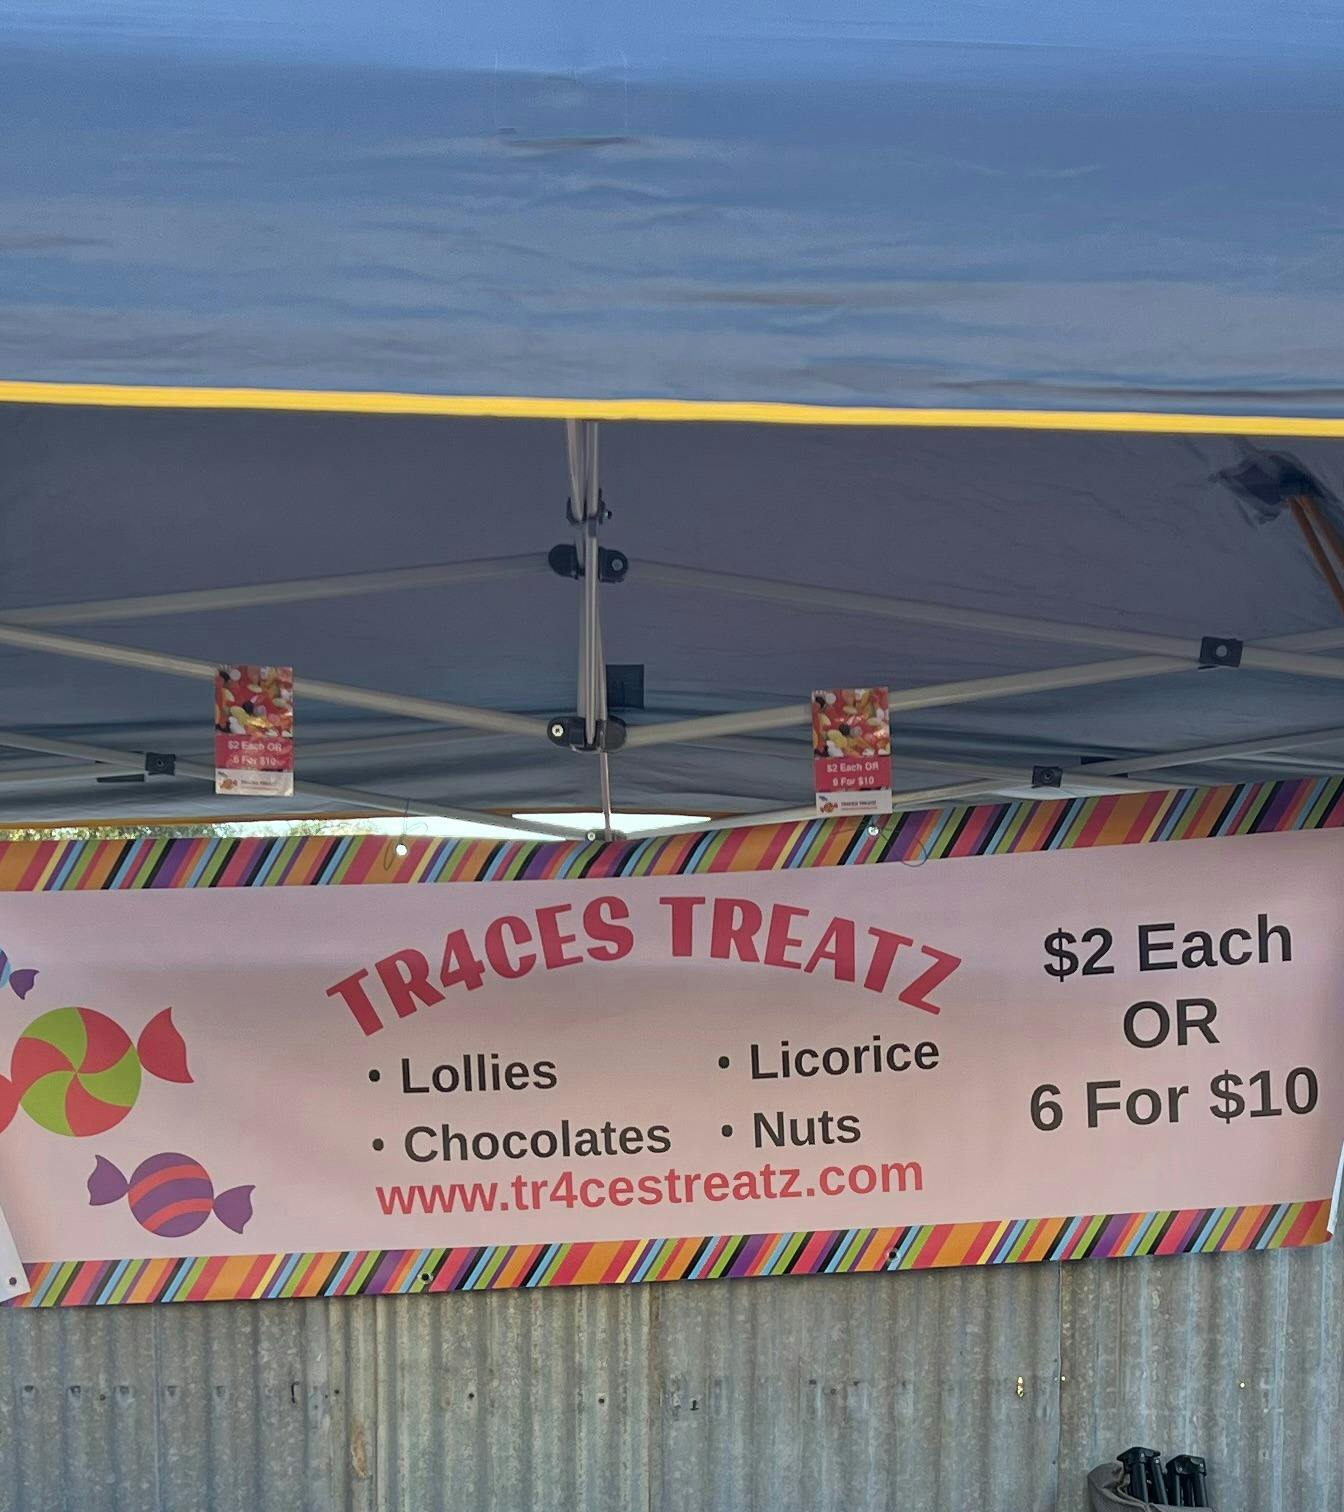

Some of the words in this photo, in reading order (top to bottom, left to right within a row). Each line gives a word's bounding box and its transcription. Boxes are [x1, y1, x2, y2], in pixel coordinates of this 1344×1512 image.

[840, 762, 862, 772] Each
[864, 761, 878, 770] OR
[840, 776, 855, 785] For
[857, 776, 874, 785] $10
[325, 896, 634, 1036] TR4CES
[659, 896, 961, 1015] TREATZ
[1043, 927, 1116, 983] $2
[1138, 913, 1293, 972] Each
[1123, 997, 1220, 1049] OR
[401, 1053, 558, 1094] Lollies
[751, 1035, 941, 1080] Licorice
[1030, 1083, 1063, 1131] 6
[1086, 1079, 1190, 1129] For
[1209, 1065, 1320, 1124] $10
[404, 1119, 672, 1163] Chocolates
[754, 1107, 862, 1148] Nuts
[376, 1160, 924, 1216] www.tr4cestreatz.com
